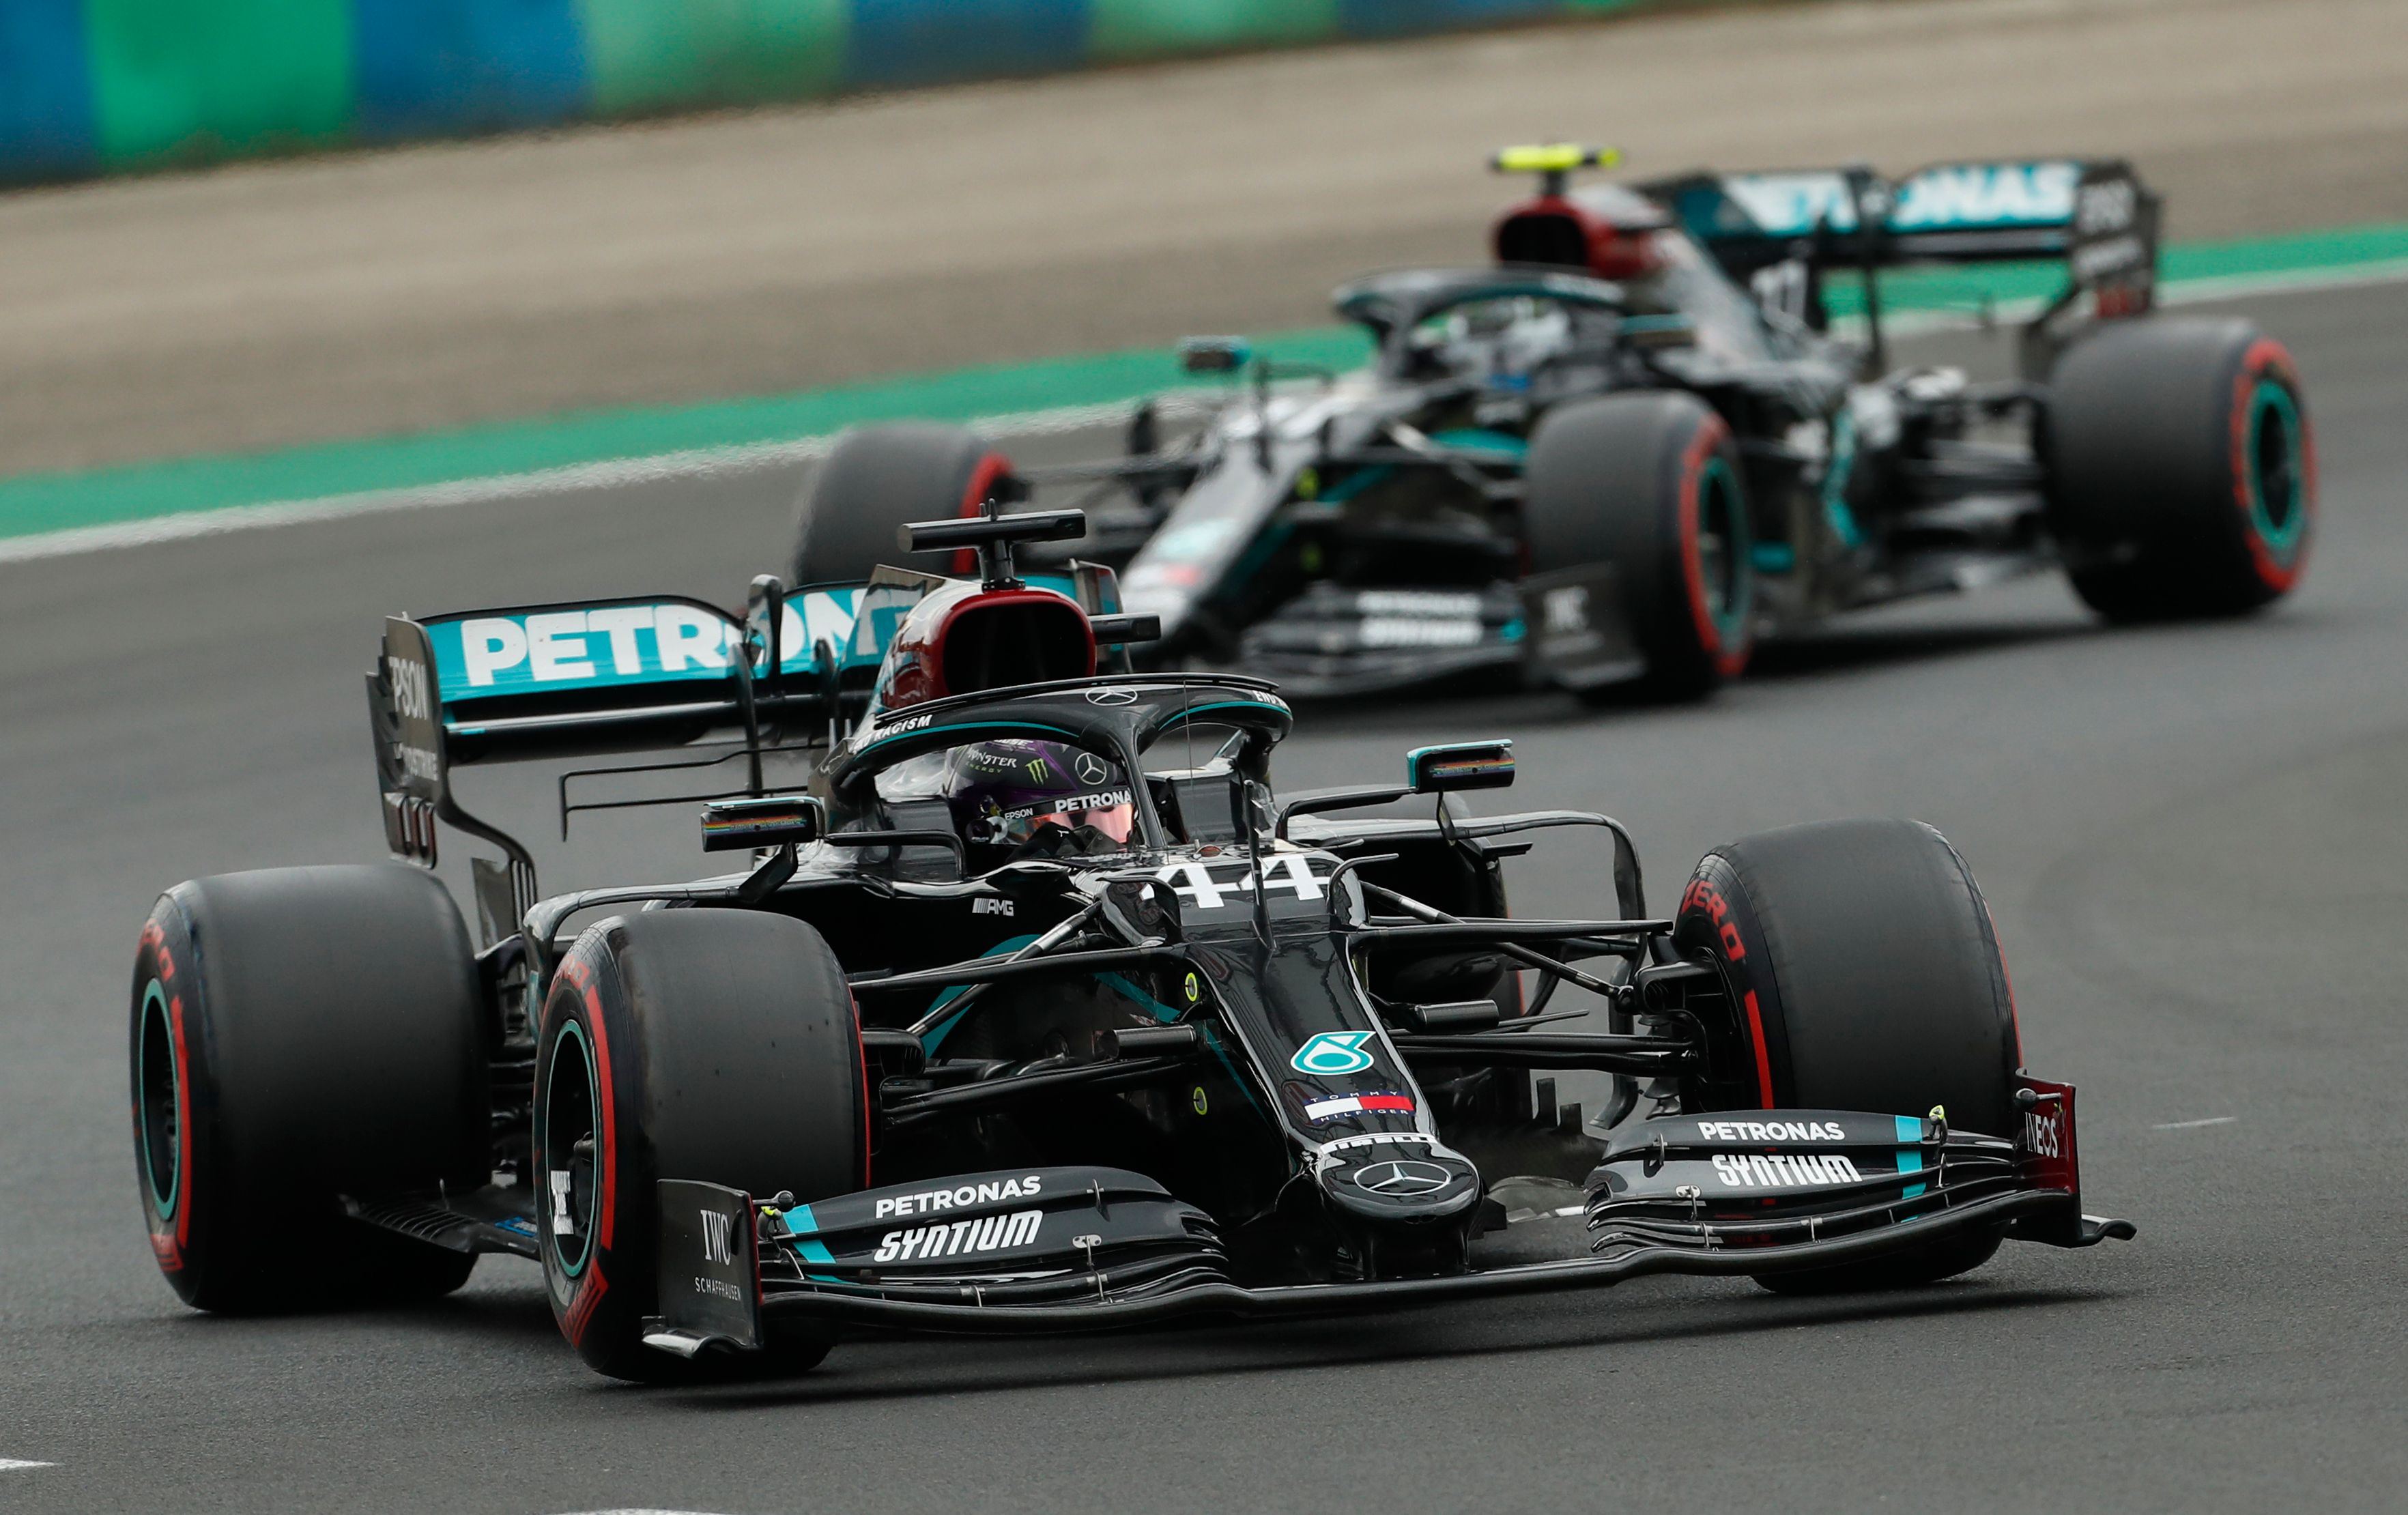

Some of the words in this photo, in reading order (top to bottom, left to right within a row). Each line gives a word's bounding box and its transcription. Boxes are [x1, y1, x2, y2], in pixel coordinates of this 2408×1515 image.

[874, 715, 932, 742] RACISM
[966, 747, 1017, 768] MONSTER
[1005, 807, 1034, 820] EPSON
[1055, 790, 1132, 813] PETRONA
[1138, 854, 1332, 909] 44
[987, 898, 1014, 917] AMG
[1310, 1091, 1399, 1103] TOMMY
[1320, 1109, 1409, 1123] HILFIGER
[1697, 1122, 1846, 1141] PETRONAS
[2024, 1111, 2059, 1159] INEOS
[1711, 1154, 1863, 1186] SYNTIUM
[875, 1175, 1042, 1220] PETRONAS
[700, 1209, 731, 1266] IWC
[874, 1209, 1044, 1262] SYNTIUM
[694, 1276, 741, 1301] SCHAFFHAUSEN
